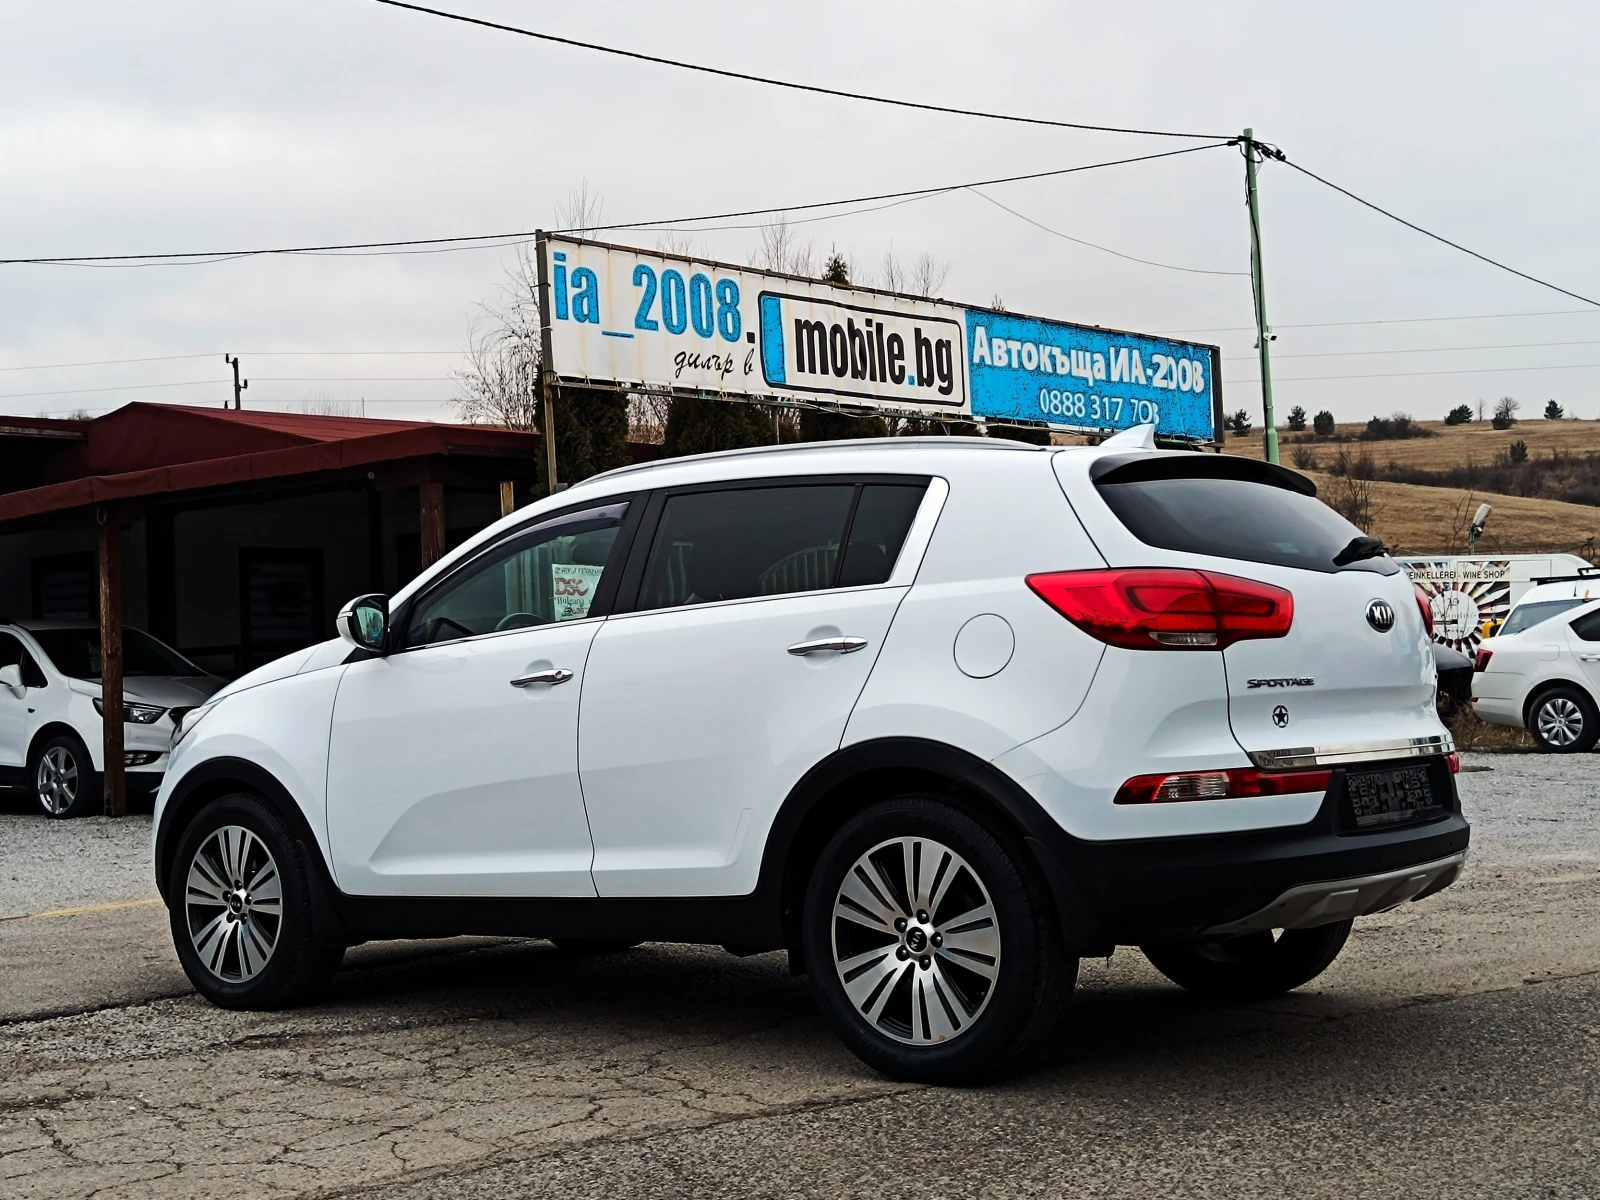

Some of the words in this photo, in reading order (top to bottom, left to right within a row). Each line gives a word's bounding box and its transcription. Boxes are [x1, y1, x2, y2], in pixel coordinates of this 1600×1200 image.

[674, 351, 735, 381] дилър
[794, 317, 954, 396] mobile.bg
[973, 325, 1107, 387] Автокъща
[1109, 346, 1205, 393] ИА-2008
[1040, 388, 1086, 418] 0888
[1090, 394, 1124, 422] 317
[1129, 398, 1160, 425] 708
[1463, 570, 1482, 579] WINE
[1483, 570, 1506, 579] SHOP
[1371, 605, 1393, 624] KIA
[1247, 677, 1315, 689] SPORTAGE
[910, 931, 922, 950] KIA
